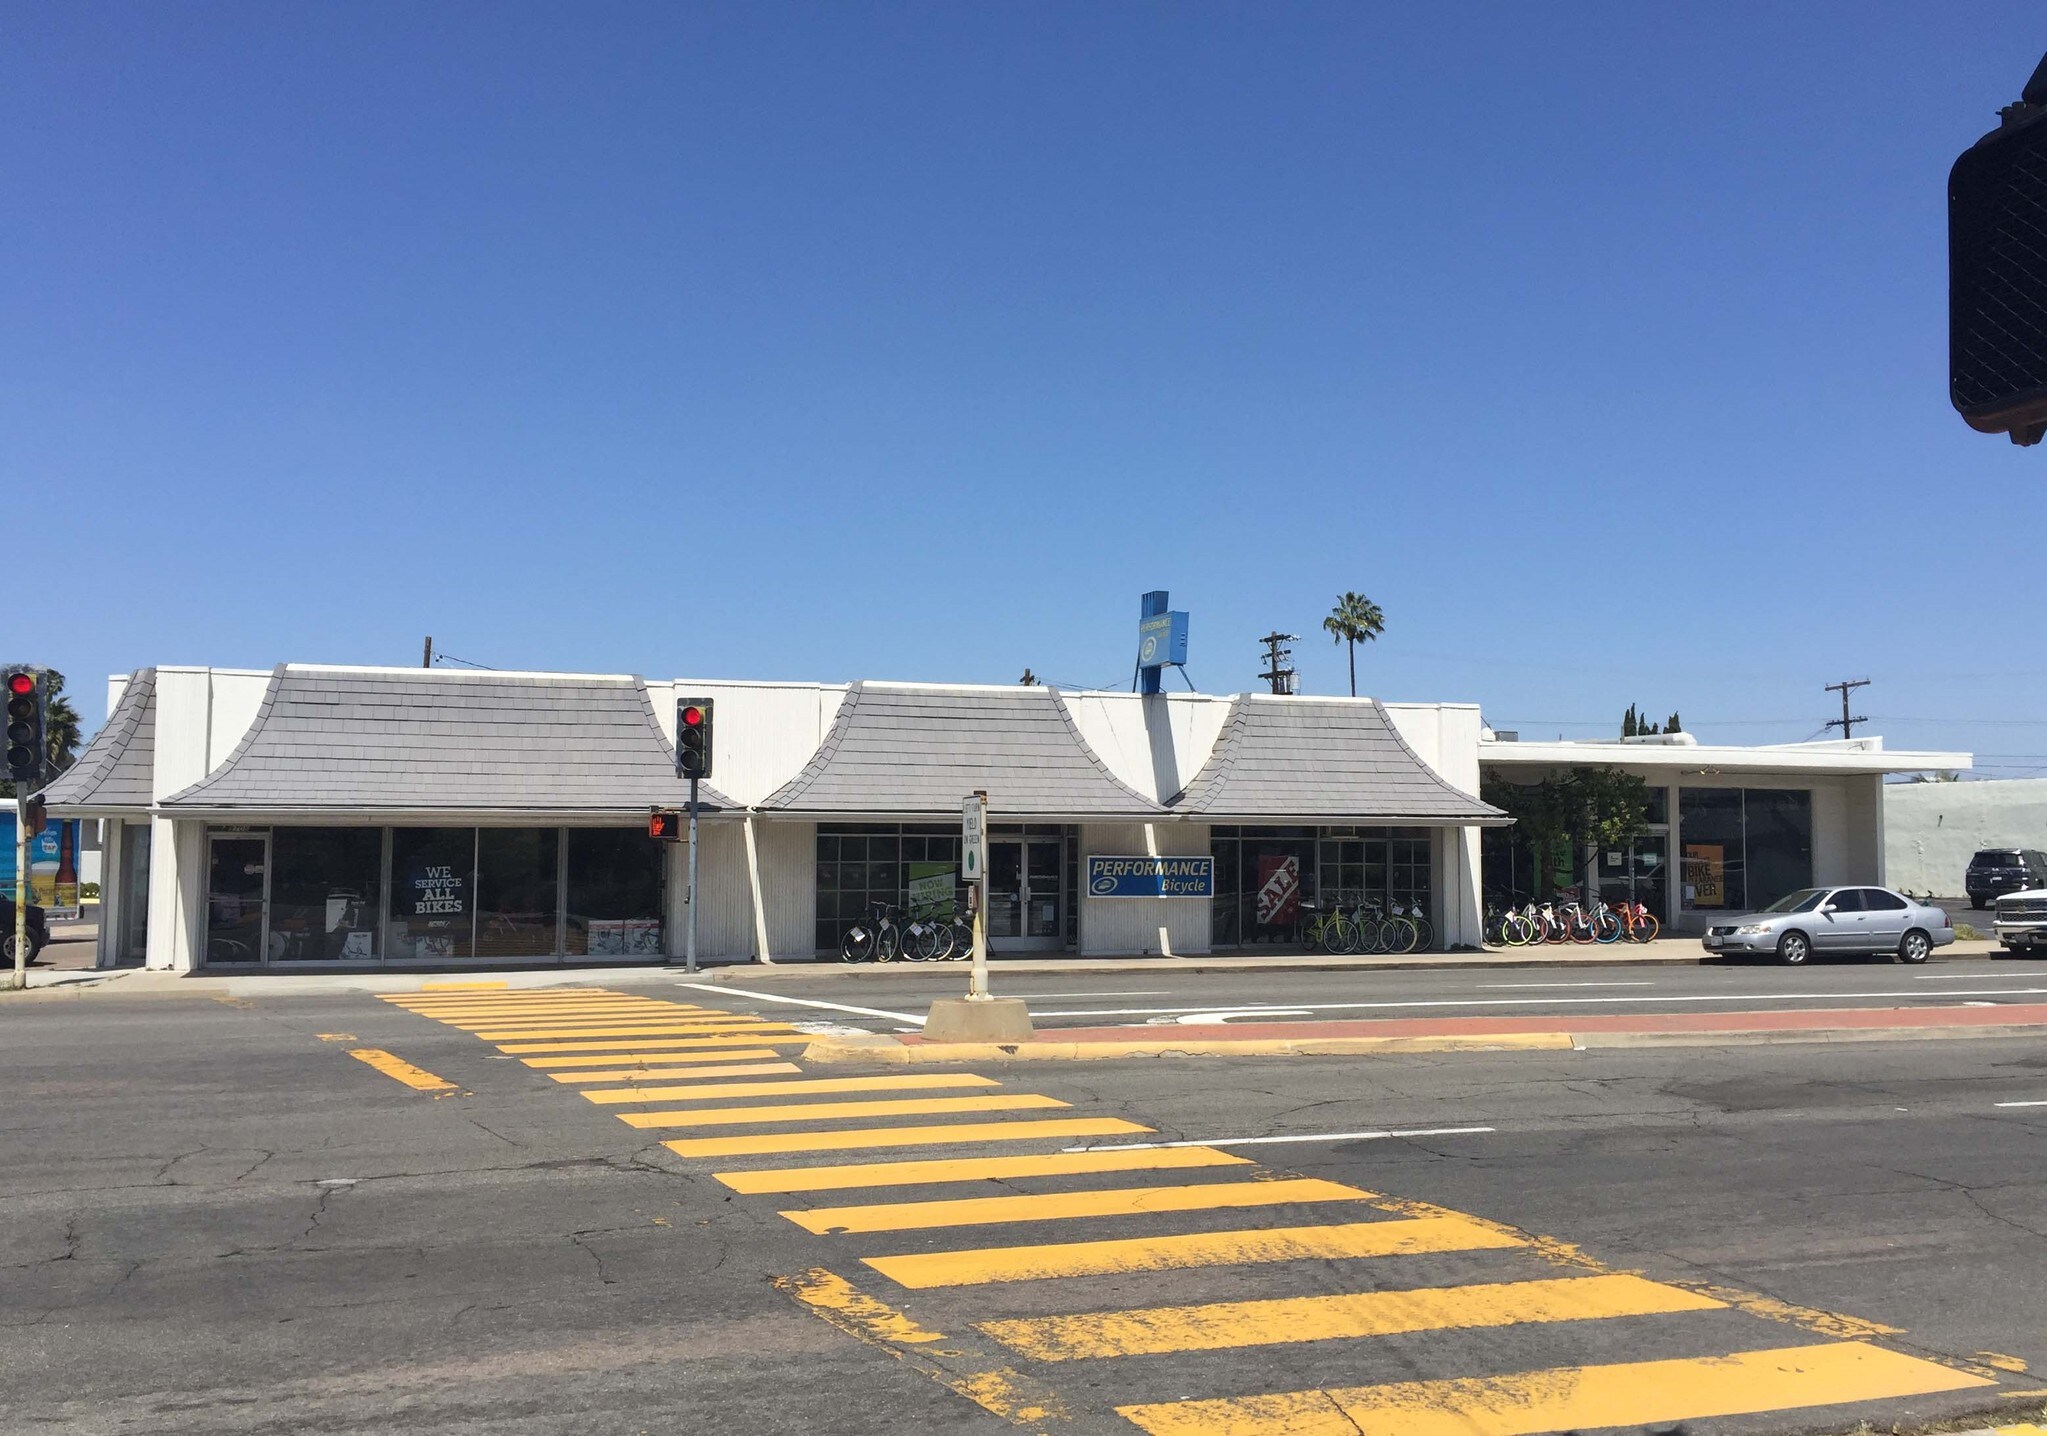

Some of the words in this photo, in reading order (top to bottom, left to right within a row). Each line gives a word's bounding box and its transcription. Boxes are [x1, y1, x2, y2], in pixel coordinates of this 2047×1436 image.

[425, 866, 451, 879] WE
[1092, 860, 1210, 876] PERFORMANCE
[1687, 862, 1712, 880] BIKE
[414, 877, 463, 889] SERVICE
[918, 878, 944, 891] NOW
[1161, 878, 1206, 894] Bicycle
[1256, 857, 1299, 921] SALE
[1692, 883, 1717, 898] VER
[422, 887, 455, 901] ALL
[414, 899, 463, 914] BIKES
